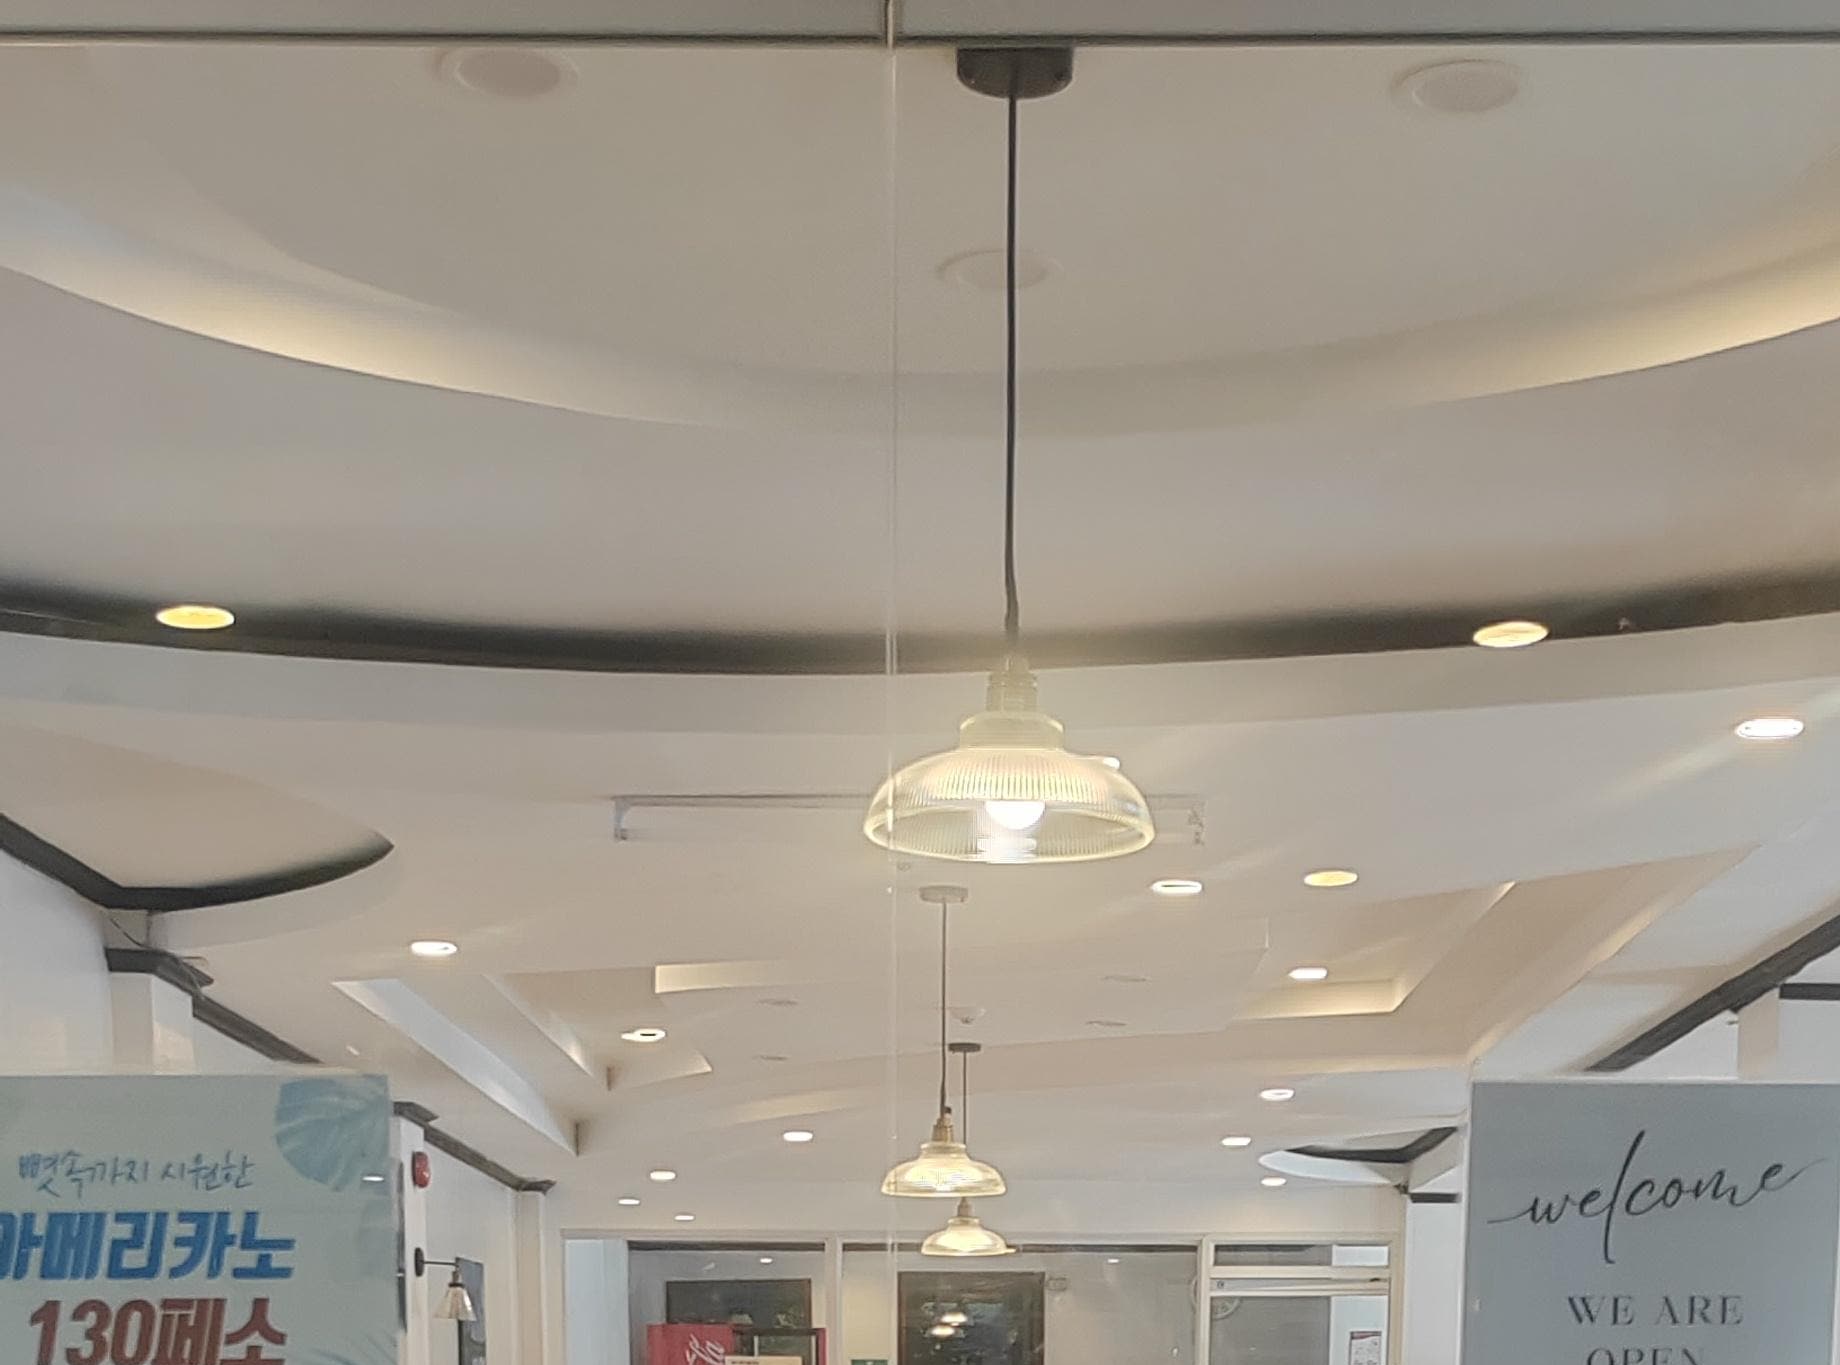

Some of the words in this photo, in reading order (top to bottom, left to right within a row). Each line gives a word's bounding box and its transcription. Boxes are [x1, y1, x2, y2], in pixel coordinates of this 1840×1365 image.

[160, 1150, 256, 1191] 시원한
[1487, 1130, 1826, 1264] welcome
[0, 1211, 295, 1280] 아메리카노
[1568, 1295, 1634, 1326] WE
[1654, 1295, 1744, 1326] ARE
